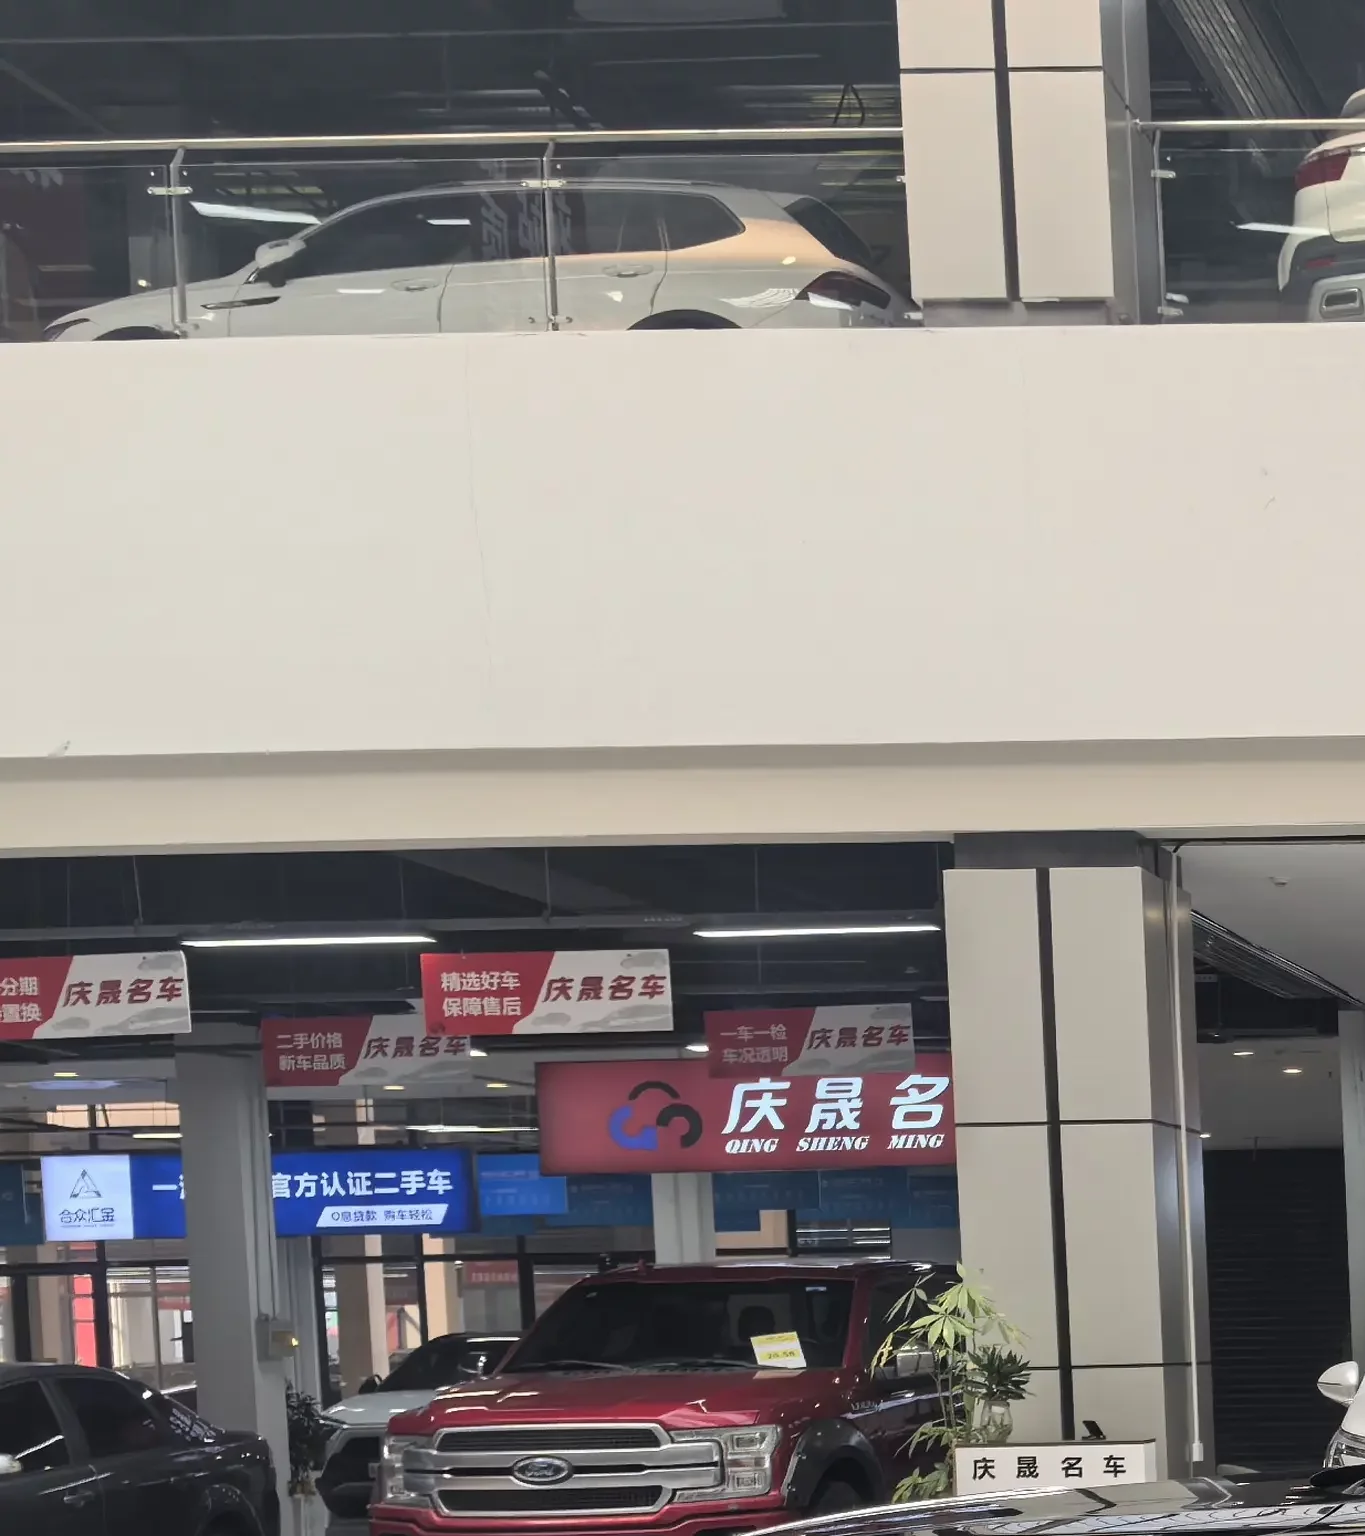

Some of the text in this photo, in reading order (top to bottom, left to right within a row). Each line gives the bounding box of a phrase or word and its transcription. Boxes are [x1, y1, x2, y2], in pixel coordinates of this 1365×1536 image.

[0, 976, 39, 997] 分期
[62, 976, 185, 1008] 庆晟名车
[440, 971, 521, 992] 精选好车
[543, 974, 667, 1004] 庆晟名车
[0, 1003, 43, 1023] 置换
[442, 996, 522, 1018] 保障售后
[276, 1032, 343, 1050] 二手价格
[720, 1023, 788, 1043] 一车一检
[807, 1024, 911, 1050] 庆晟名车
[363, 1036, 468, 1060] 庆晟名车
[722, 1046, 788, 1064] 车况透明
[278, 1054, 347, 1072] 新车品质
[721, 1074, 950, 1135] 庆晟名
[725, 1133, 945, 1154] QING SHENG MING
[271, 1168, 453, 1199] 官方认证二手车
[58, 1207, 115, 1224] 合众汇金
[972, 1455, 1127, 1480] 庆晟名车
